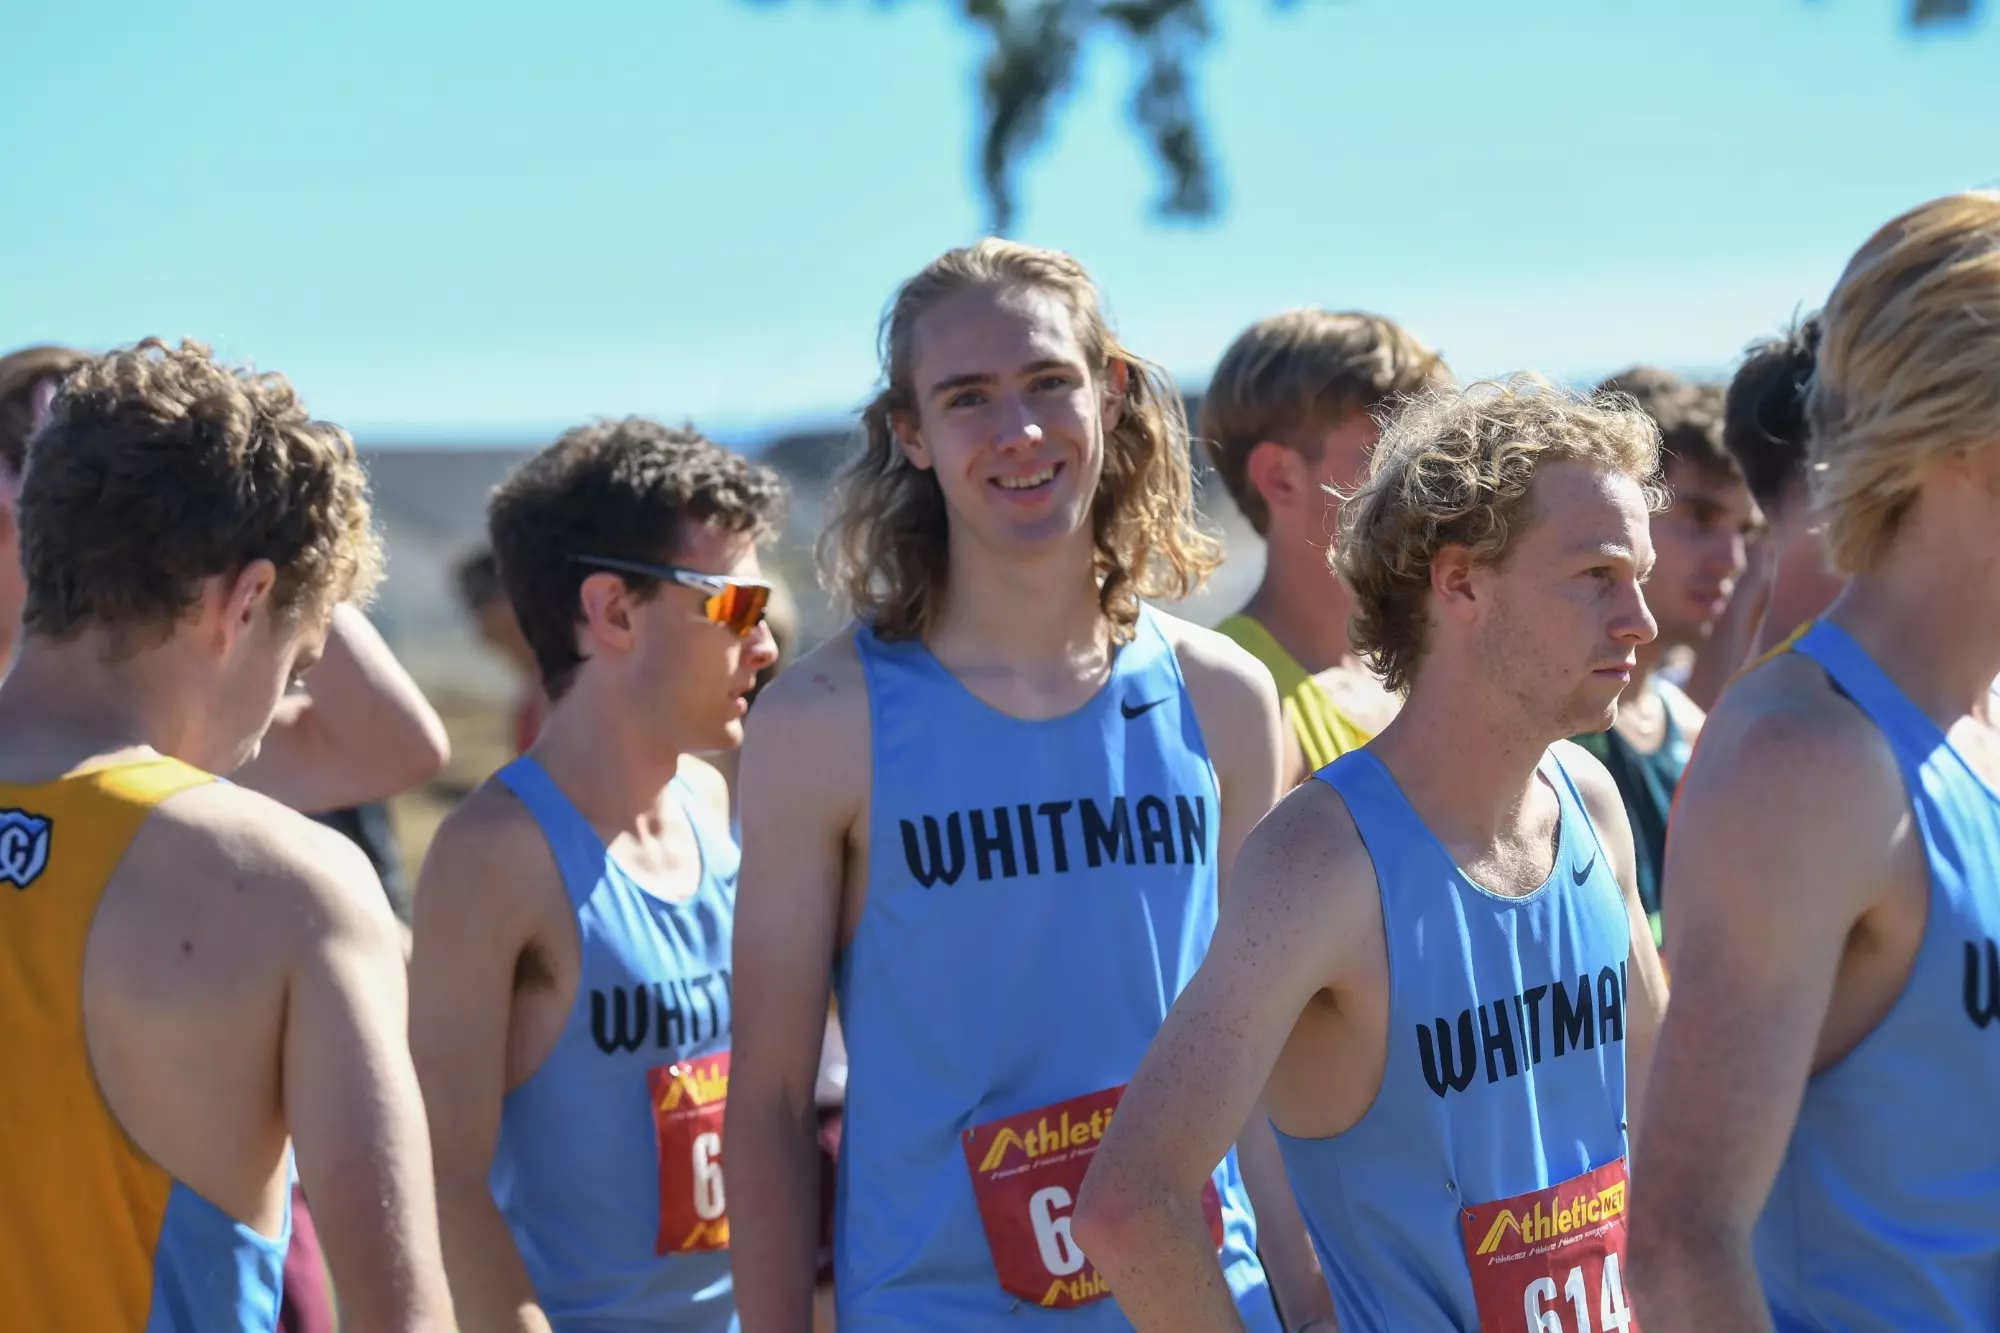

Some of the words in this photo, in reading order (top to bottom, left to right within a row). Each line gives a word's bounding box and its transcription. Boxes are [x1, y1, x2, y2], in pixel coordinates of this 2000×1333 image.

[900, 795, 1206, 889] WHITMAN
[1416, 961, 1627, 1098] WHITMA
[1524, 1252, 1632, 1333] 614
